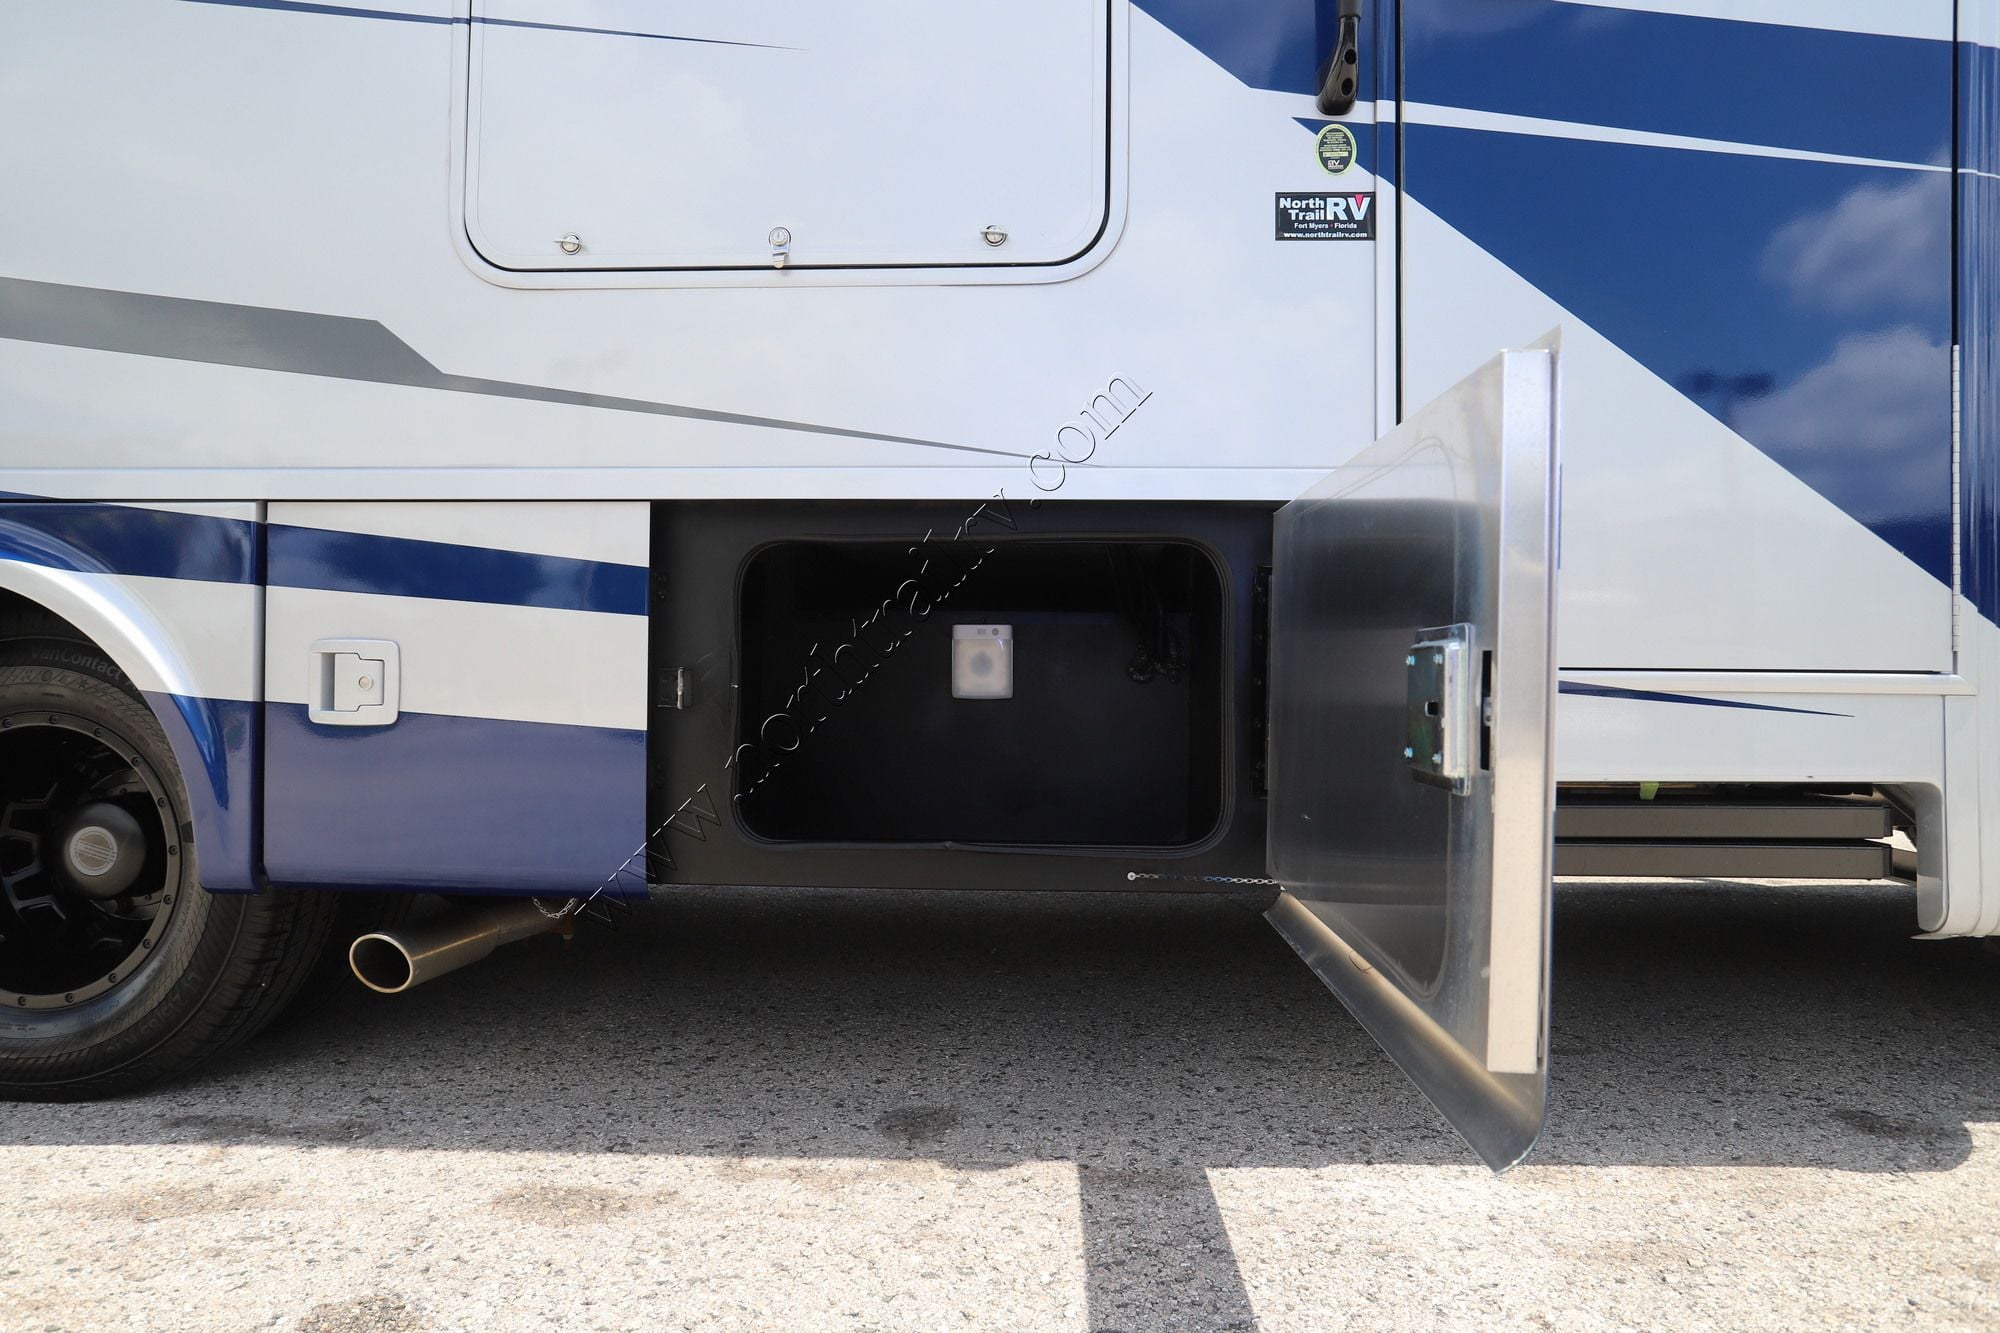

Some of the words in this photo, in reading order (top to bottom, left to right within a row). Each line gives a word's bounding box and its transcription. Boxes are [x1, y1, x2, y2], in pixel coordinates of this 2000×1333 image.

[1280, 198, 1325, 209] North
[1326, 197, 1371, 220] RV
[1288, 209, 1325, 221] Trail
[1309, 222, 1329, 230] Myers
